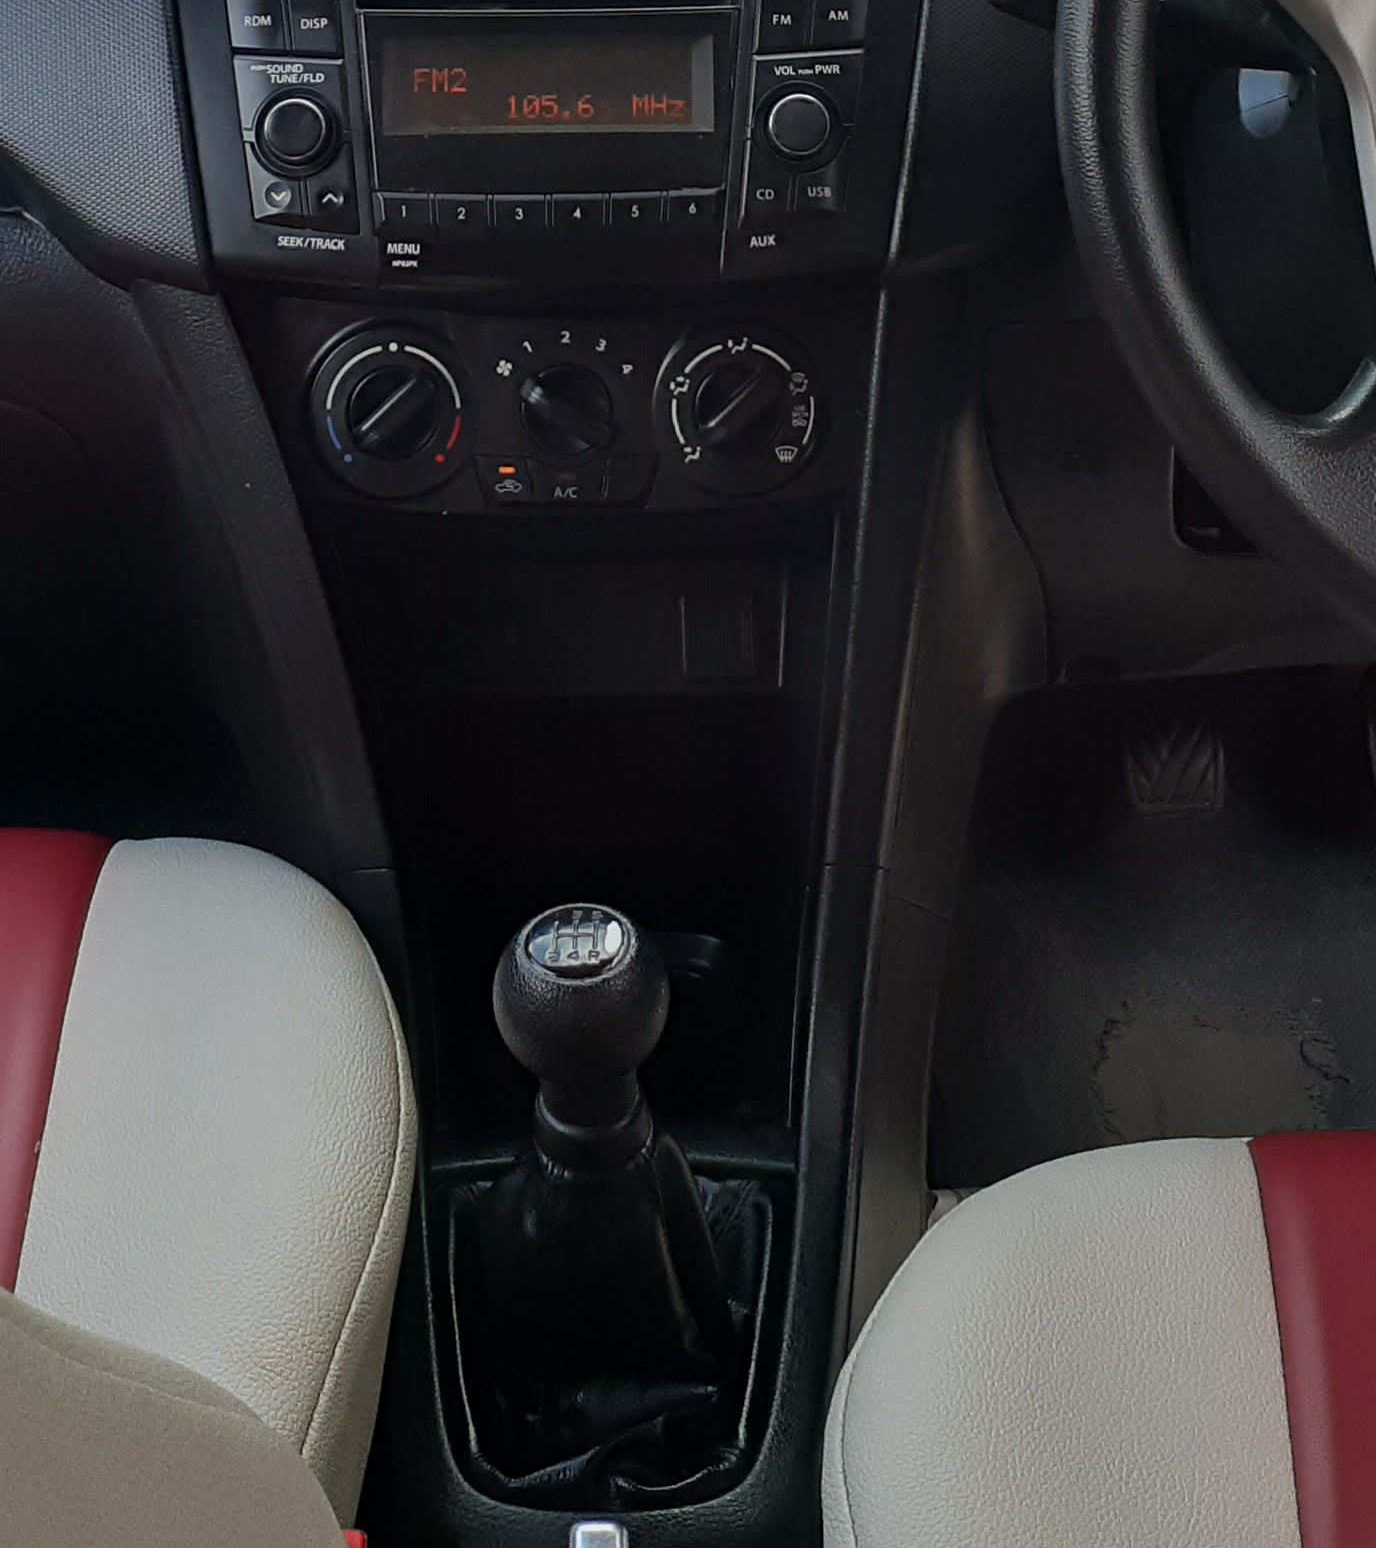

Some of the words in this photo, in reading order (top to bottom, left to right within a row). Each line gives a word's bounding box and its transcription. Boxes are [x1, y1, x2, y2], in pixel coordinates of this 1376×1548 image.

[244, 15, 272, 27] RDM
[772, 14, 792, 25] FM
[828, 10, 849, 21] AM
[300, 17, 328, 30] DISP
[266, 63, 304, 74] SOUND
[773, 65, 796, 76] VOL
[814, 64, 841, 75] PWR
[270, 73, 325, 84] TUNE/FLD
[413, 68, 468, 93] FM2
[506, 94, 595, 120] 105.6
[632, 93, 687, 118] MHz
[756, 188, 775, 200] CD
[807, 186, 832, 198] USB
[401, 205, 407, 218] 1
[457, 207, 466, 220] 2
[515, 208, 524, 220] 3
[573, 207, 582, 219] 4
[631, 205, 640, 218] 5
[689, 202, 697, 215] 6
[277, 236, 345, 251] SEEK/TRACK
[750, 234, 776, 248] AUX
[387, 243, 421, 255] MENU
[560, 331, 571, 344] 2
[522, 341, 533, 353] 1
[595, 338, 607, 352] 3
[622, 364, 634, 375] 4
[554, 487, 578, 499] A/C
[567, 949, 580, 962] 4
[588, 949, 600, 962] R
